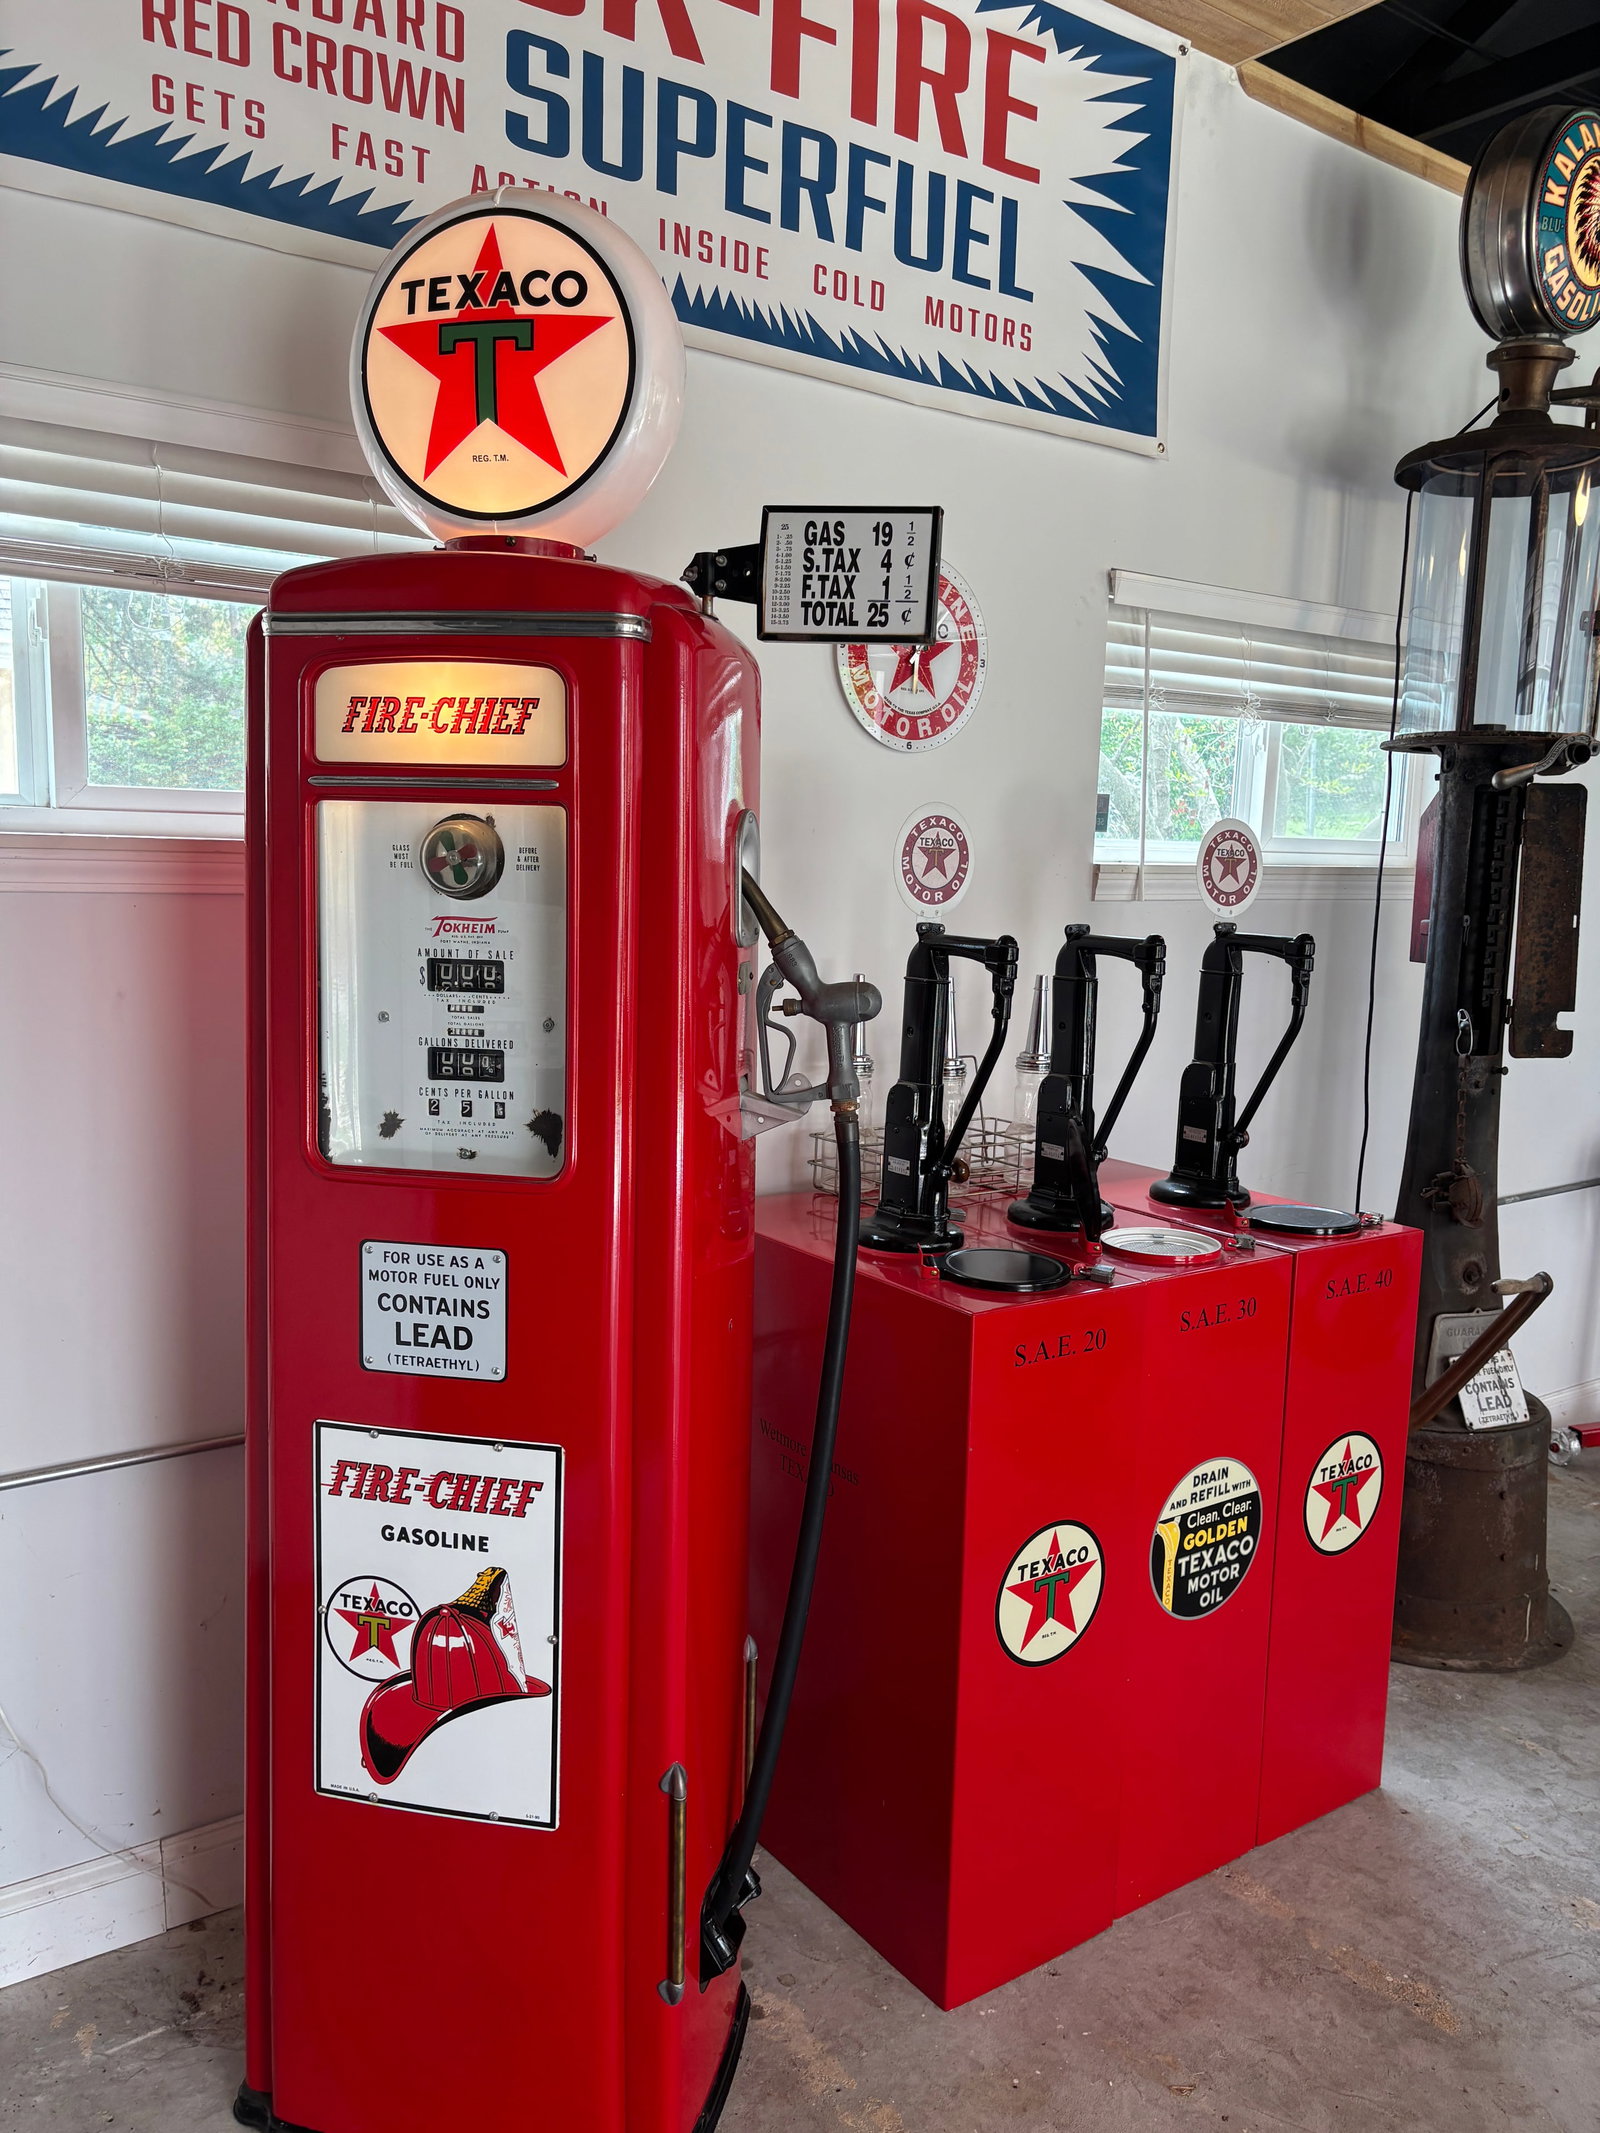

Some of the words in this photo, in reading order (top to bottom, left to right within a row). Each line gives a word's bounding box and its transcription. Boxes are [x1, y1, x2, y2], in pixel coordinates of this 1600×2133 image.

[141, 0, 250, 67] RED
[272, 22, 464, 133] CROWN
[505, 29, 1034, 303] SUPERFUEL
[151, 73, 265, 140] GETS
[331, 122, 431, 184] FAST
[659, 218, 769, 280] INSIDE
[813, 263, 885, 312] COLD
[924, 296, 1032, 352] MOTORS
[400, 269, 588, 315] TEXACO
[472, 454, 492, 462] REG.
[493, 454, 509, 462] T.M.
[804, 520, 845, 546] GAS
[873, 522, 893, 546] 19
[803, 547, 861, 573] S.TAX
[881, 549, 892, 573] 4
[802, 574, 856, 599] F.TAX
[882, 576, 890, 600] 1
[801, 601, 859, 626] TOTAL
[867, 603, 889, 627] 25
[980, 659, 986, 668] 3
[850, 663, 933, 738] MOTOR
[941, 680, 973, 722] OIL
[342, 697, 540, 734] FIRE-CHIEF
[907, 742, 912, 750] 6
[911, 817, 963, 841] TEXACO
[920, 837, 954, 847] TEXACO
[1210, 831, 1253, 852] TEXACO
[1217, 849, 1245, 857] TEXACO
[903, 857, 943, 901] MOTOR
[951, 862, 968, 890] OIL
[1203, 865, 1236, 904] MOTOR
[1243, 869, 1257, 894] OIL
[432, 916, 498, 938] TOKHEIM
[418, 948, 459, 958] AMOUNT
[469, 949, 479, 958] OF
[488, 950, 514, 960] SALE
[419, 1037, 458, 1047] GALLONS
[465, 1039, 514, 1049] DELIVERED
[419, 1087, 448, 1097] CENTS
[455, 1089, 471, 1098] PER
[479, 1090, 514, 1100] GALLON
[430, 1100, 438, 1111] 2
[462, 1102, 470, 1113] 5
[383, 1251, 410, 1264] FOR
[417, 1253, 445, 1267] USE
[450, 1255, 469, 1269] AS
[475, 1257, 484, 1269] A
[369, 1270, 418, 1284] MOTOR
[424, 1273, 459, 1288] FUEL
[464, 1276, 500, 1290] ONLY
[1326, 1274, 1371, 1299] S.A.E.
[1375, 1269, 1393, 1289] 40
[377, 1293, 490, 1319] CONTAINS
[1179, 1303, 1231, 1332] S.A.E.
[1237, 1297, 1257, 1319] 30
[395, 1321, 473, 1351] LEAD
[1014, 1334, 1076, 1368] S.A.E.
[1083, 1328, 1107, 1353] 20
[1480, 1395, 1512, 1412] LEAD
[1193, 1466, 1229, 1488] DRAIN
[1321, 1454, 1372, 1482] TEXACO
[328, 1459, 544, 1518] FIRE-CHIEF
[1169, 1498, 1187, 1511] AND
[1190, 1482, 1230, 1505] REFILL
[1232, 1479, 1251, 1492] WITH
[381, 1525, 489, 1553] GASOLINE
[1184, 1516, 1248, 1550] GOLDEN
[1018, 1546, 1088, 1582] TEXACO
[1178, 1535, 1254, 1578] TEXACO
[1187, 1563, 1240, 1595] MOTOR
[340, 1593, 413, 1617] TEXACO
[1200, 1587, 1223, 1608] OIL
